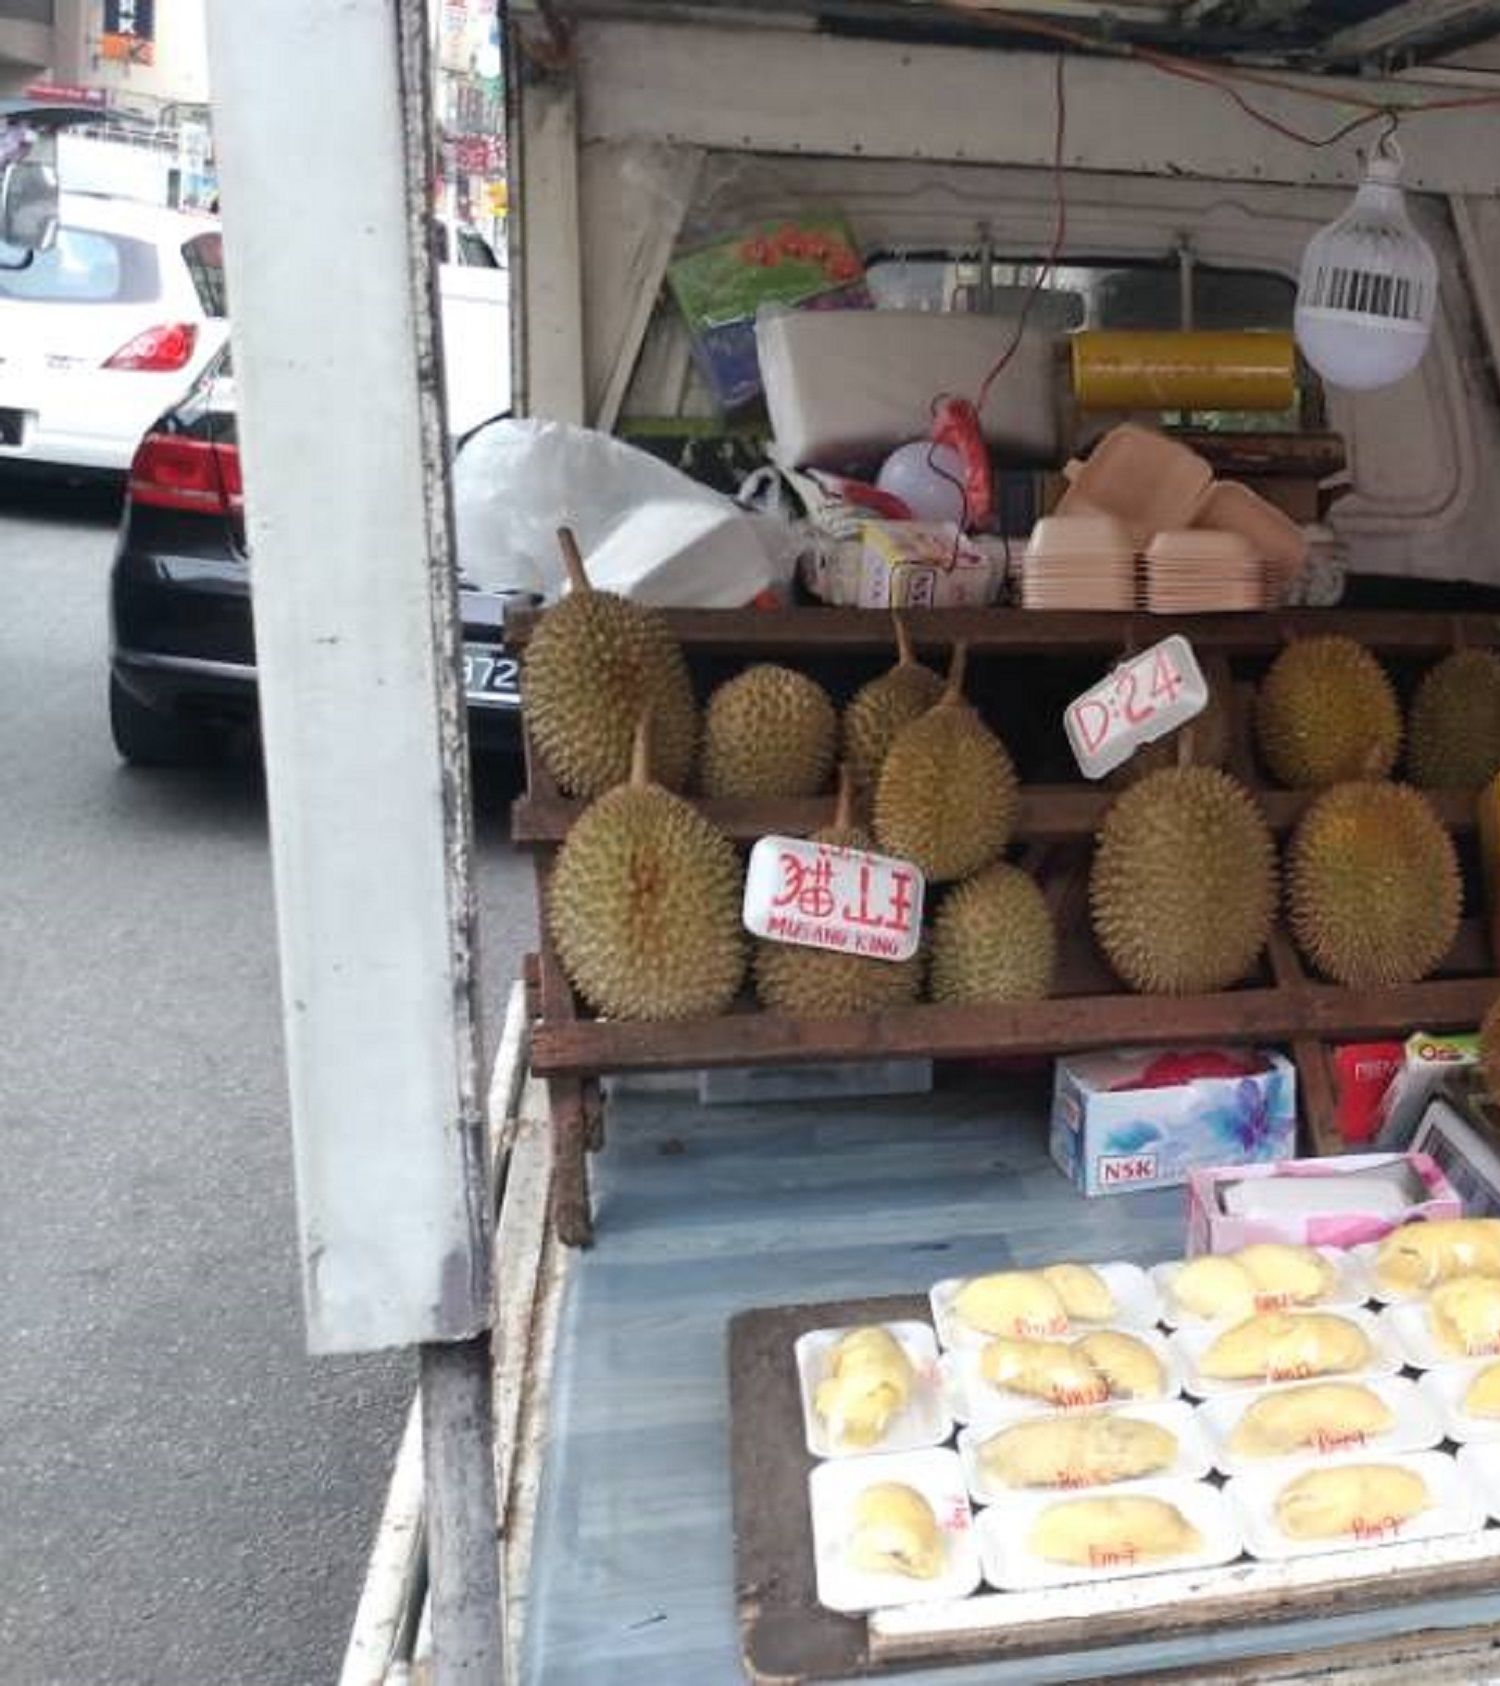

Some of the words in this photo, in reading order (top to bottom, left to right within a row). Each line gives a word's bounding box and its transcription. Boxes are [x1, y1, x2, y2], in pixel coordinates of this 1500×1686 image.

[767, 914, 847, 947] MUSANG
[854, 933, 899, 956] KING
[1104, 1158, 1152, 1181] NSK
